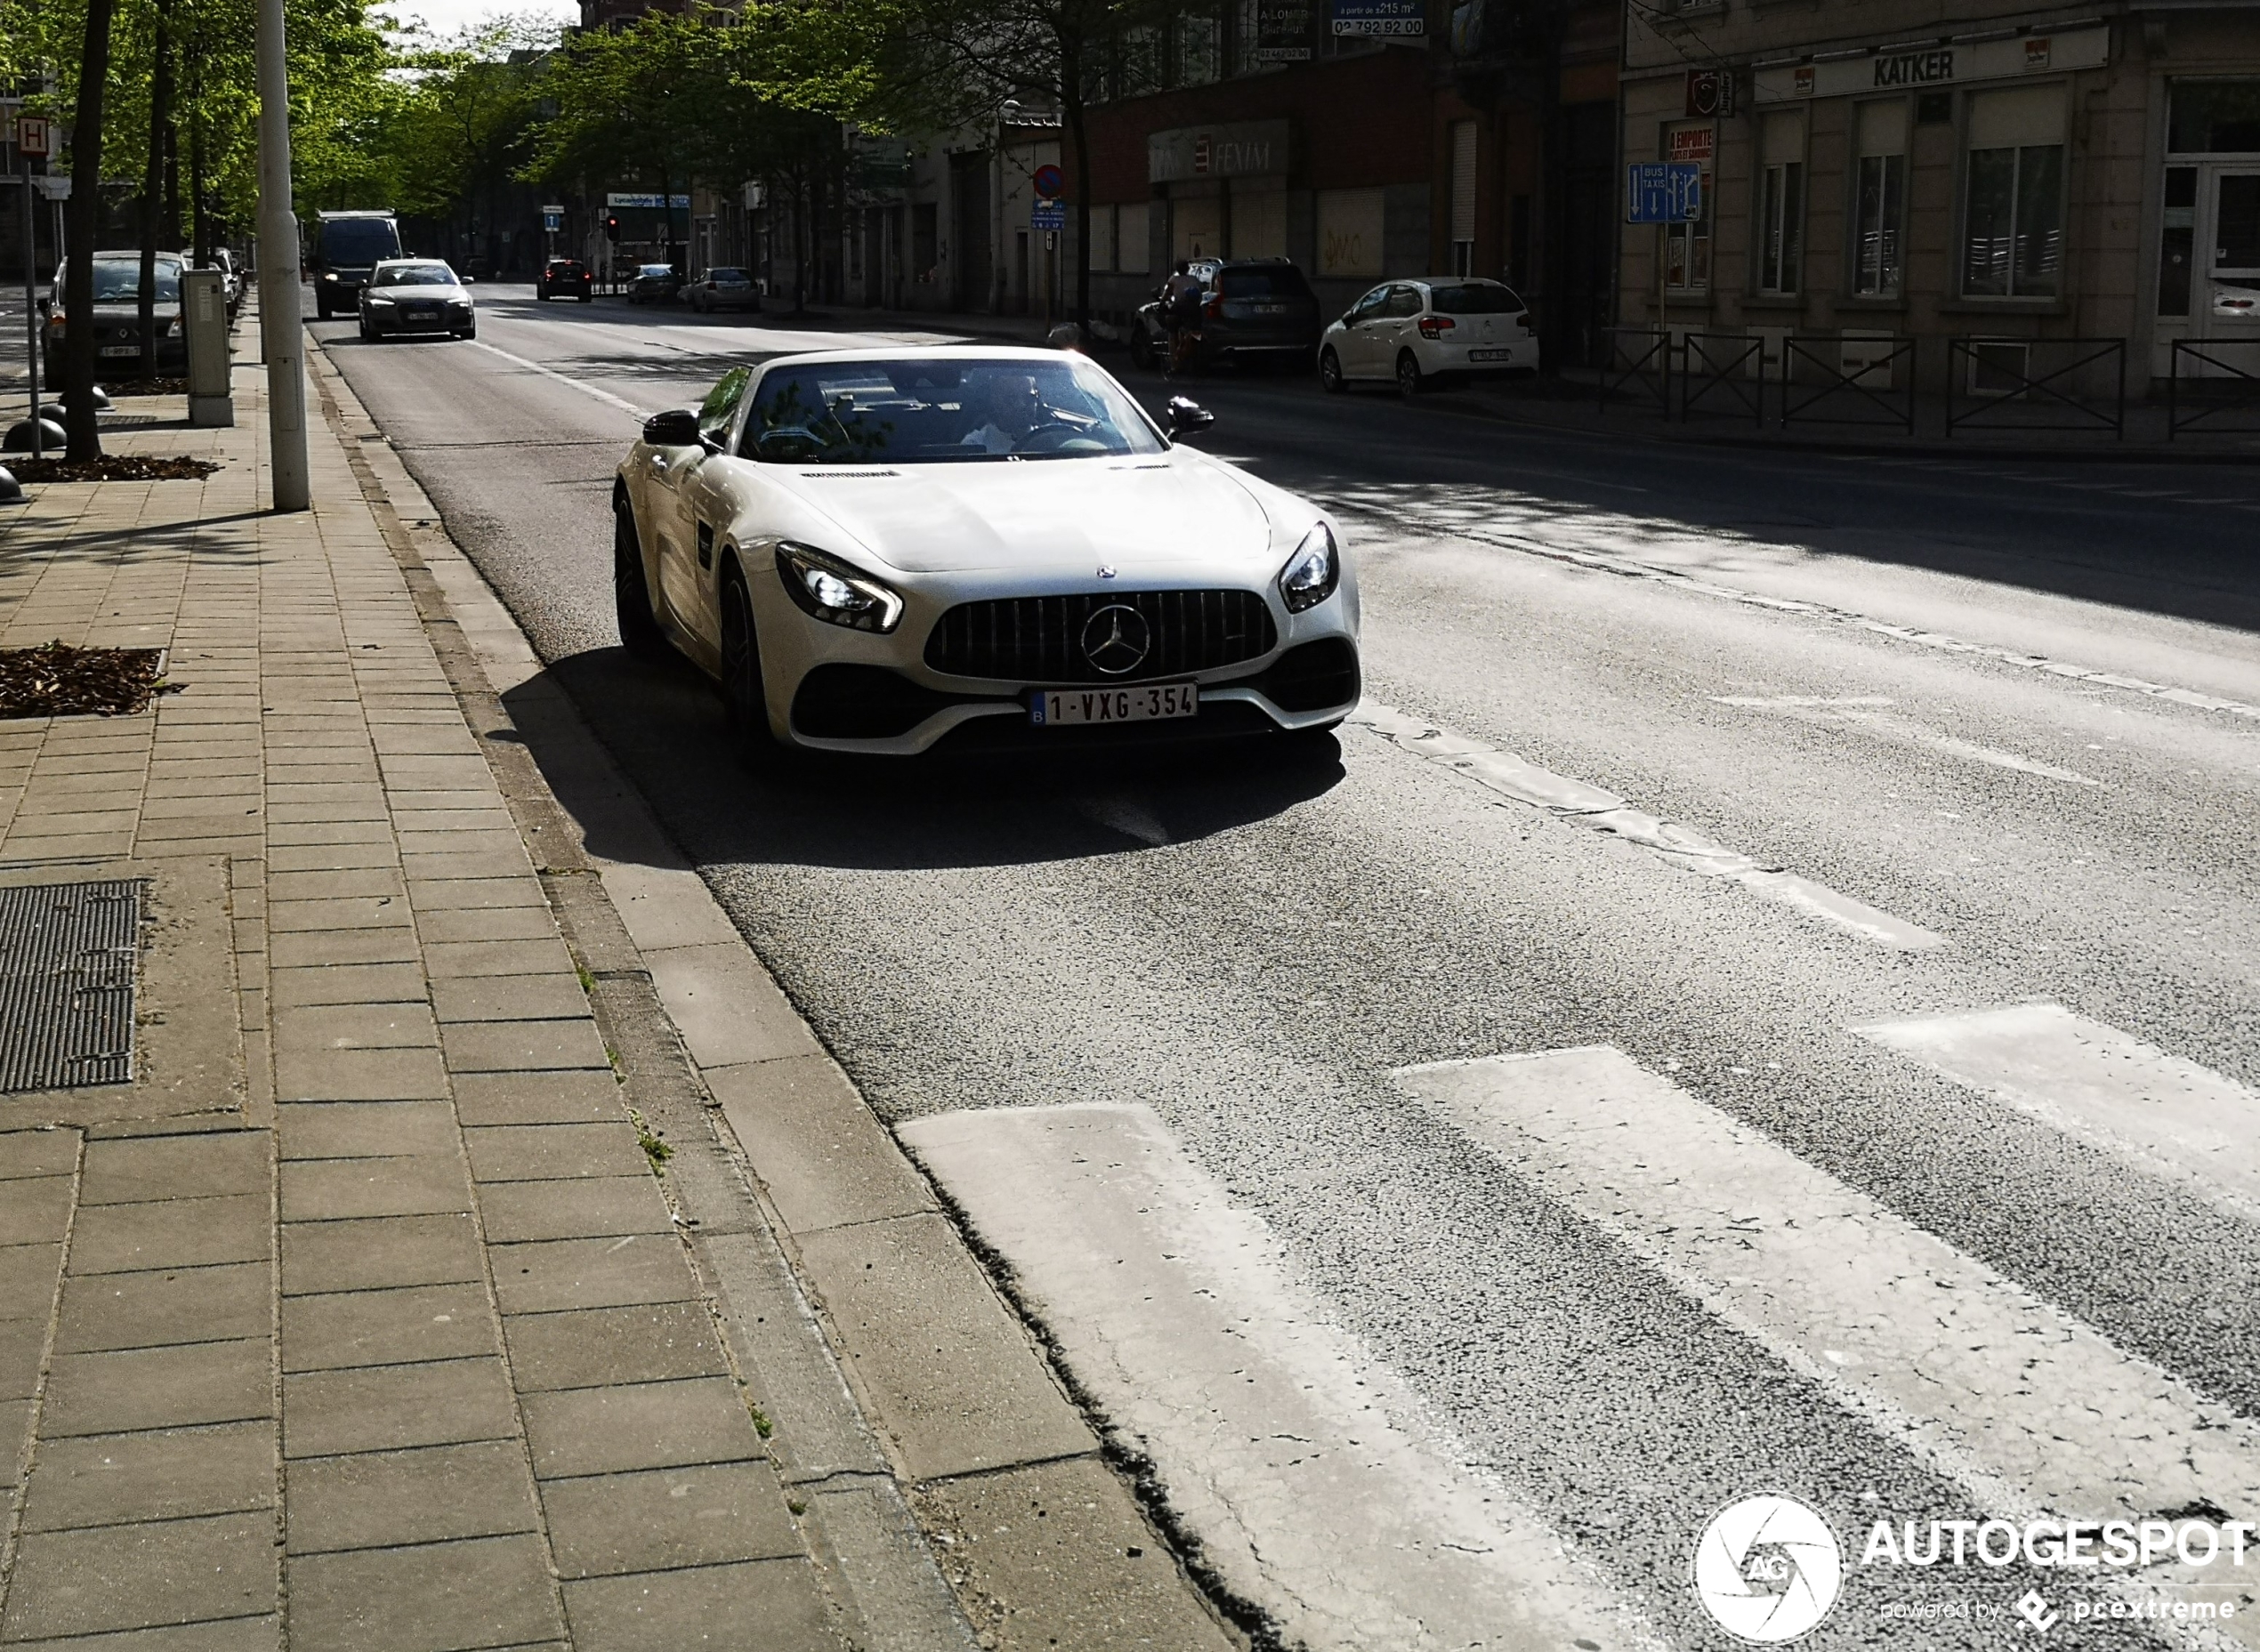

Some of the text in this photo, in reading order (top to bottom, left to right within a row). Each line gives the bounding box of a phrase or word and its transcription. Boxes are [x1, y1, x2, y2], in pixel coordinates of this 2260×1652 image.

[1260, 10, 1267, 20] A
[1346, 7, 1363, 16] partir
[1356, 20, 1380, 34] 792
[1384, 20, 1400, 33] 92
[1406, 20, 1422, 33] 00
[1874, 51, 1954, 86] KATKER
[1720, 73, 1731, 115] Jupiler
[25, 123, 41, 147] H
[1215, 141, 1270, 173] FEXIM
[1644, 167, 1663, 177] BUS
[1643, 179, 1666, 189] TAXIS
[1051, 688, 1192, 721] 1-VXG-354
[1033, 711, 1043, 723] B
